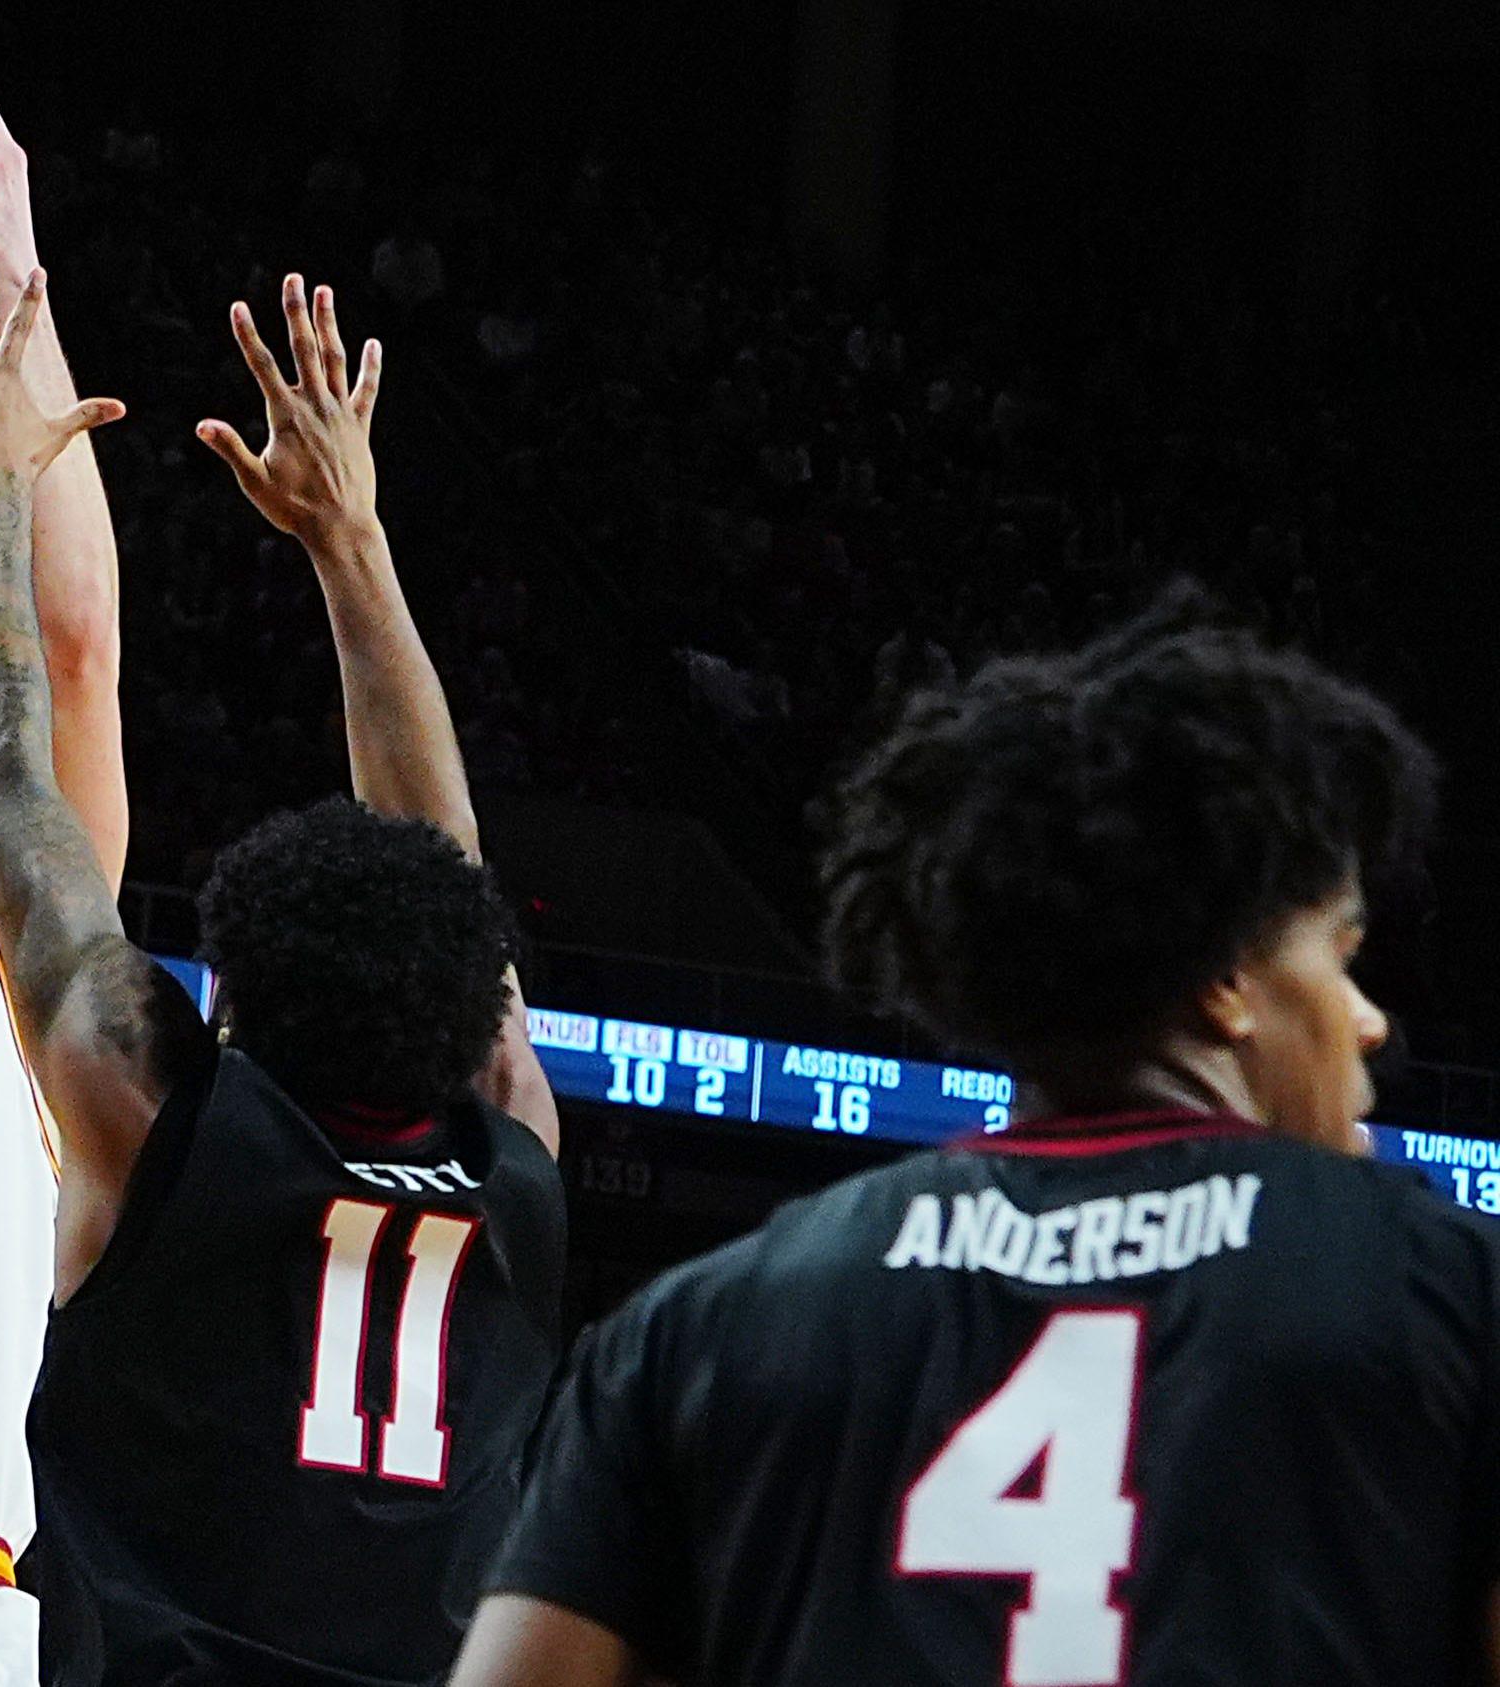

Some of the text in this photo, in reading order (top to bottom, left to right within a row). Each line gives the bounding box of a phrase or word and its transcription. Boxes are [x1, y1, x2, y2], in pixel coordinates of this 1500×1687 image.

[690, 1035, 737, 1065] TOL
[782, 1045, 901, 1090] ASSISTS
[606, 1056, 667, 1107] 10
[694, 1067, 726, 1115] 2
[942, 1067, 1012, 1104] REBO
[811, 1080, 871, 1135] 16
[1451, 1167, 1500, 1215] 13
[884, 1173, 1263, 1286] ANDERSON
[297, 1198, 481, 1490] 11
[894, 1302, 1145, 1687] 4
